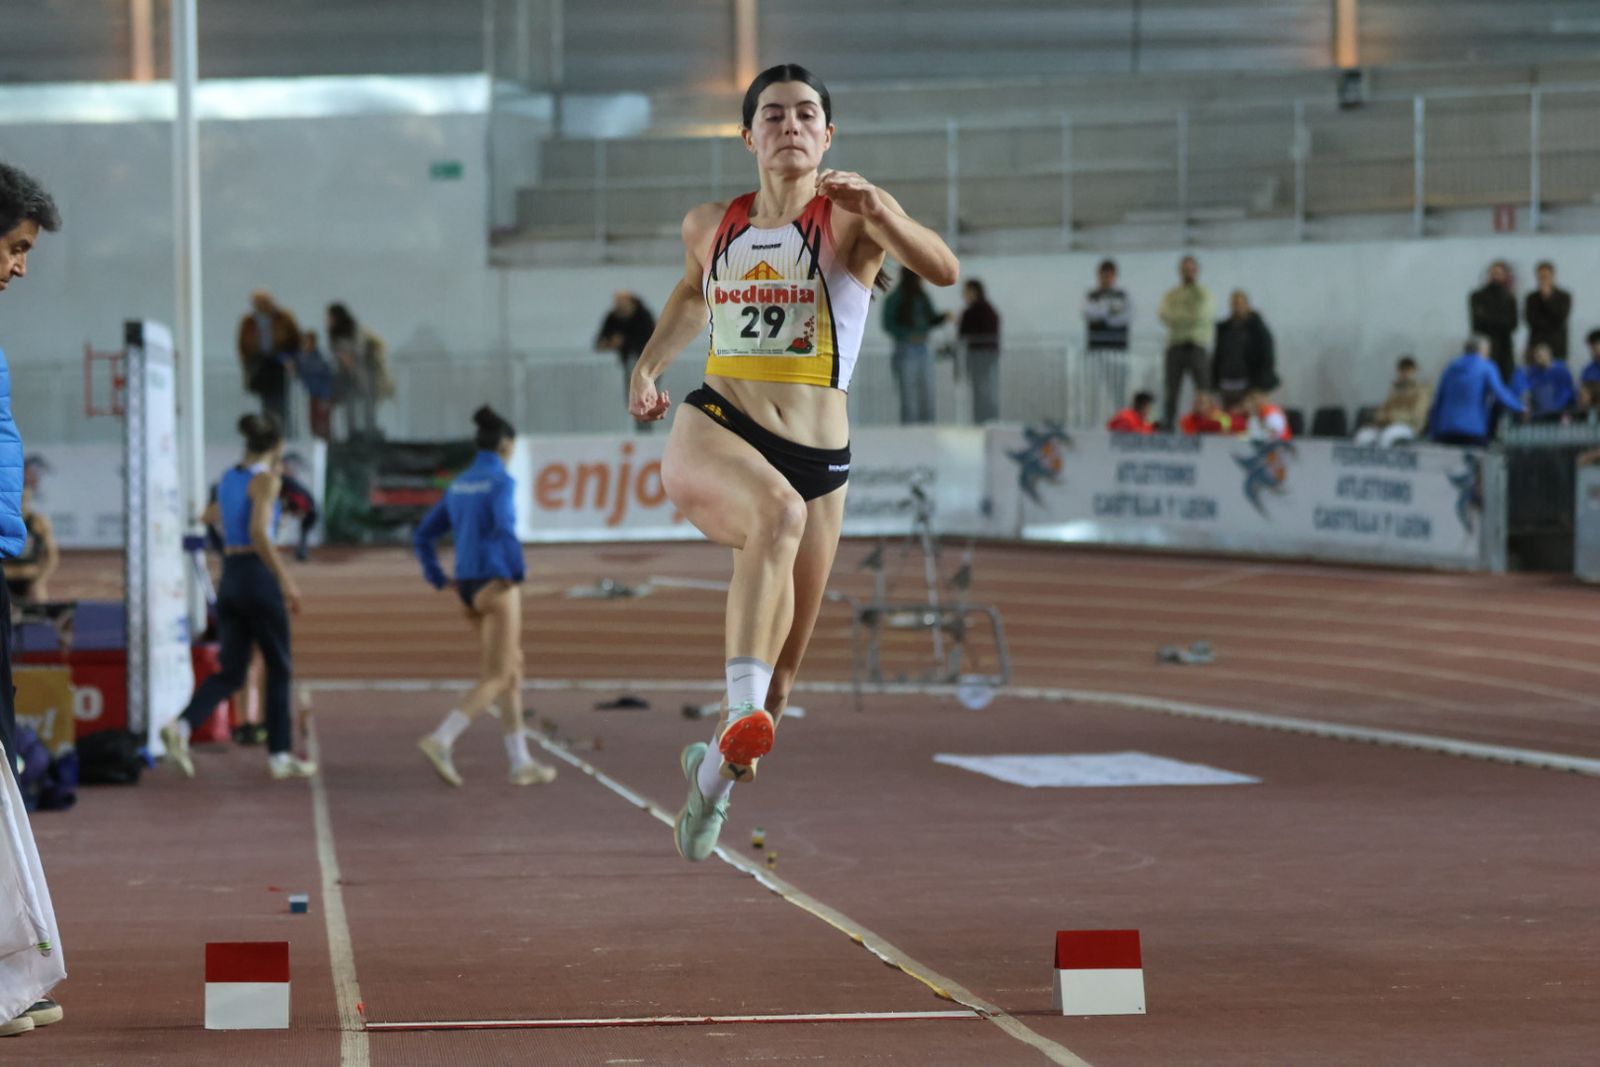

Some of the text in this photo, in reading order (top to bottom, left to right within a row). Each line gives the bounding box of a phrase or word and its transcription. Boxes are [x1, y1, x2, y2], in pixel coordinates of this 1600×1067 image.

[714, 284, 815, 305] bedunia
[740, 305, 786, 339] 29
[534, 441, 685, 528] enjo
